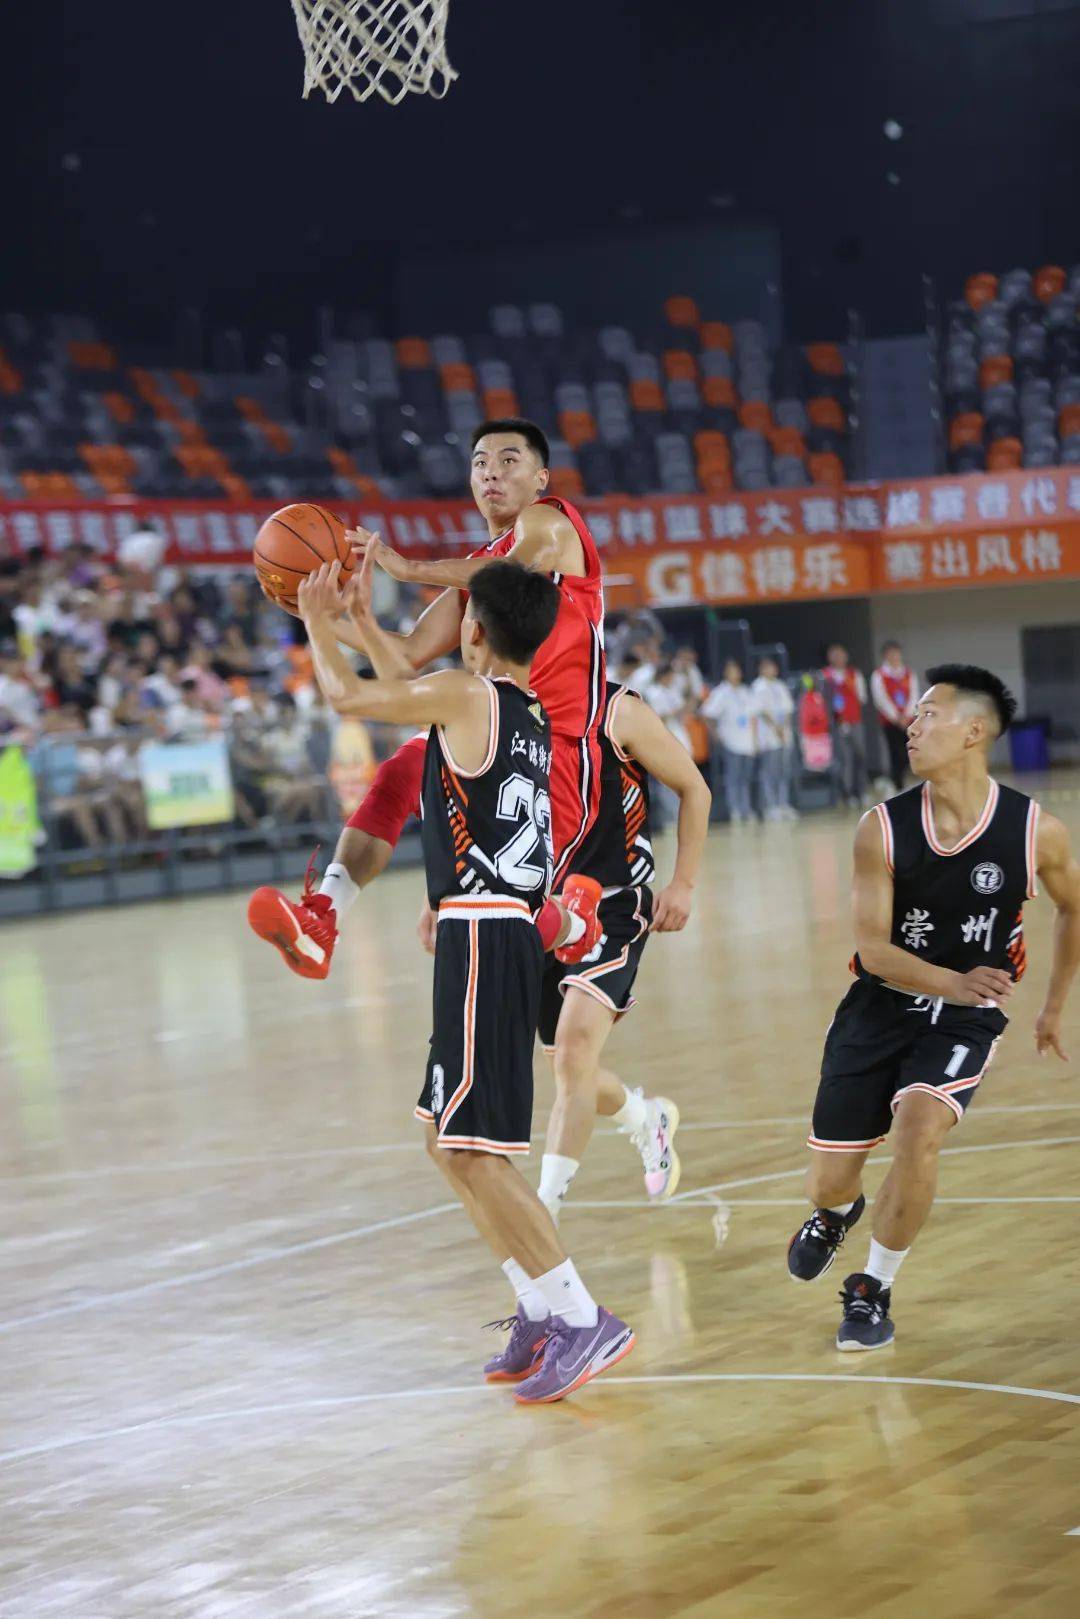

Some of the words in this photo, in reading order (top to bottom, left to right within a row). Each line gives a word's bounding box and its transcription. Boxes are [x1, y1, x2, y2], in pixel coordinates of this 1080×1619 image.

[884, 529, 1062, 582] 赛出风格
[901, 908, 999, 952] 崇州
[944, 1044, 970, 1078] 1
